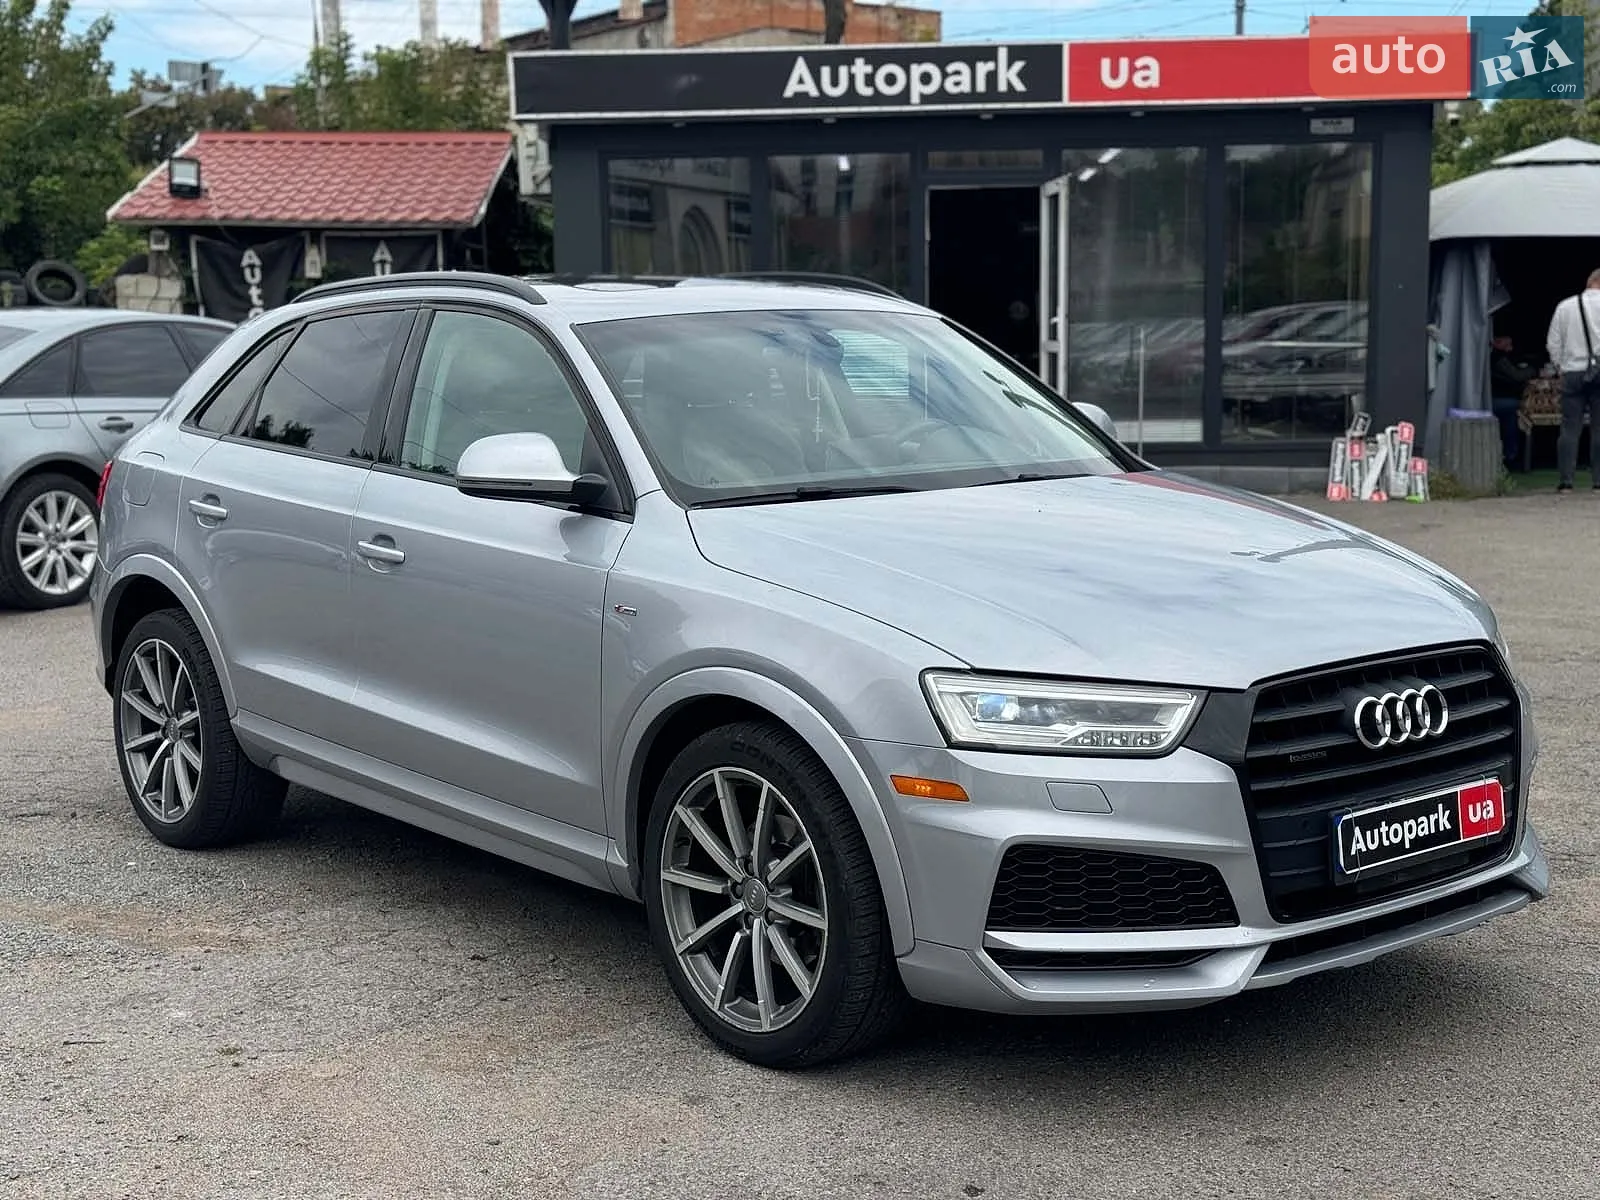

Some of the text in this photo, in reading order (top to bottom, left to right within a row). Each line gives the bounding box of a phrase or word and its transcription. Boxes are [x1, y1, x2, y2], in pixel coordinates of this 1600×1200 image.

[783, 47, 1160, 104] Autopark ua
[1350, 799, 1495, 856] Autopark ua
